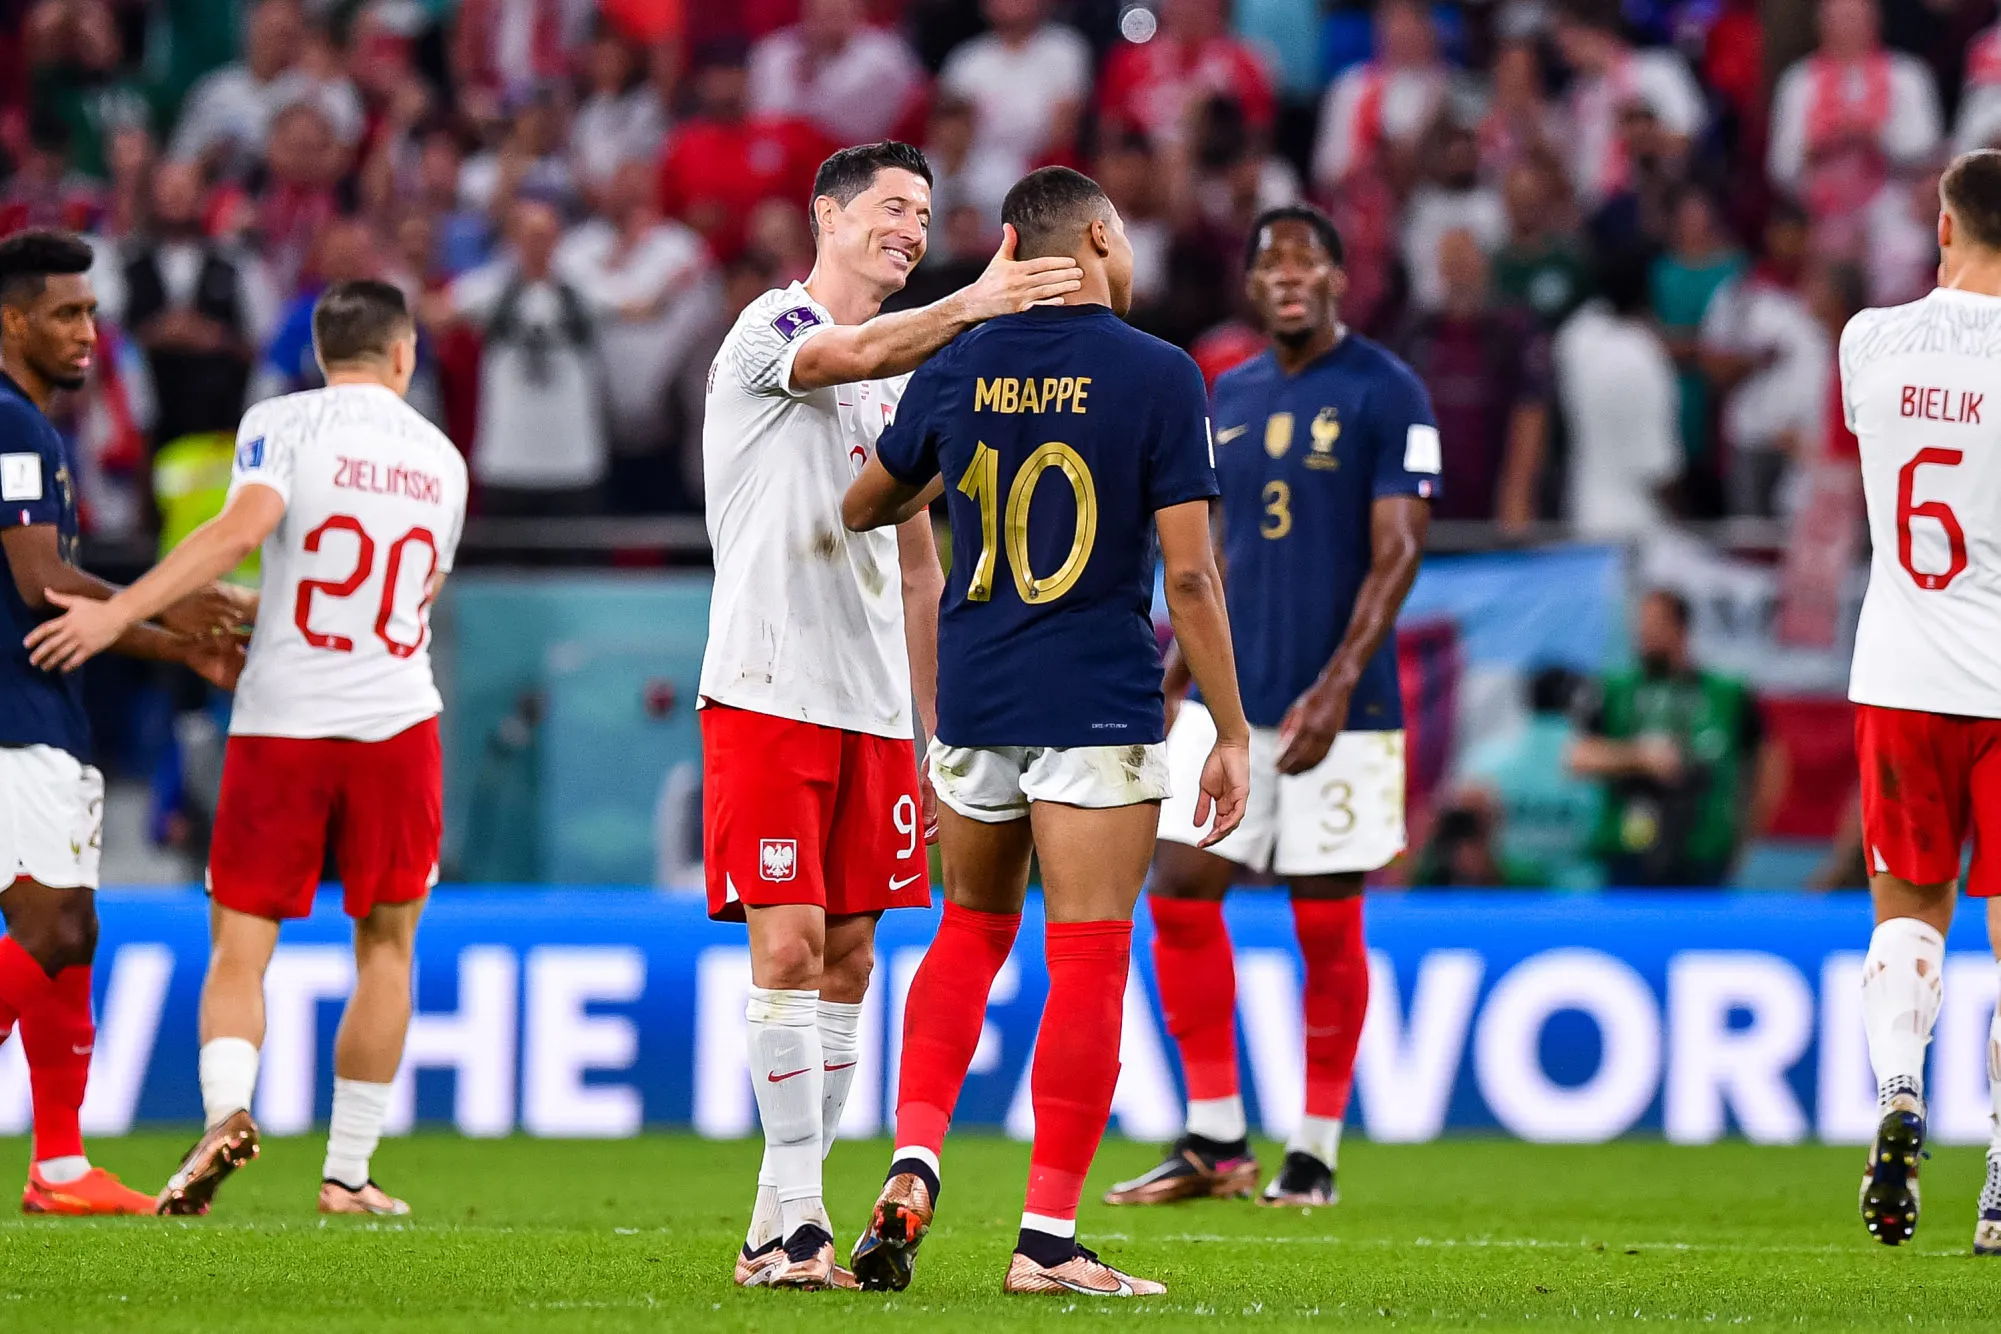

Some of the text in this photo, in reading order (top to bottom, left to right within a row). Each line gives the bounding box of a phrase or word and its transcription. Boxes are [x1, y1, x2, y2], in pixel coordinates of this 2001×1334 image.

[973, 376, 1093, 415] MBAPPE
[1900, 384, 1984, 425] BIELIK
[956, 439, 1098, 605] 10
[1260, 479, 1293, 540] 3
[1896, 446, 1968, 591] 6
[294, 514, 438, 659] 20
[892, 793, 917, 860] 9
[1319, 778, 1357, 836] 3
